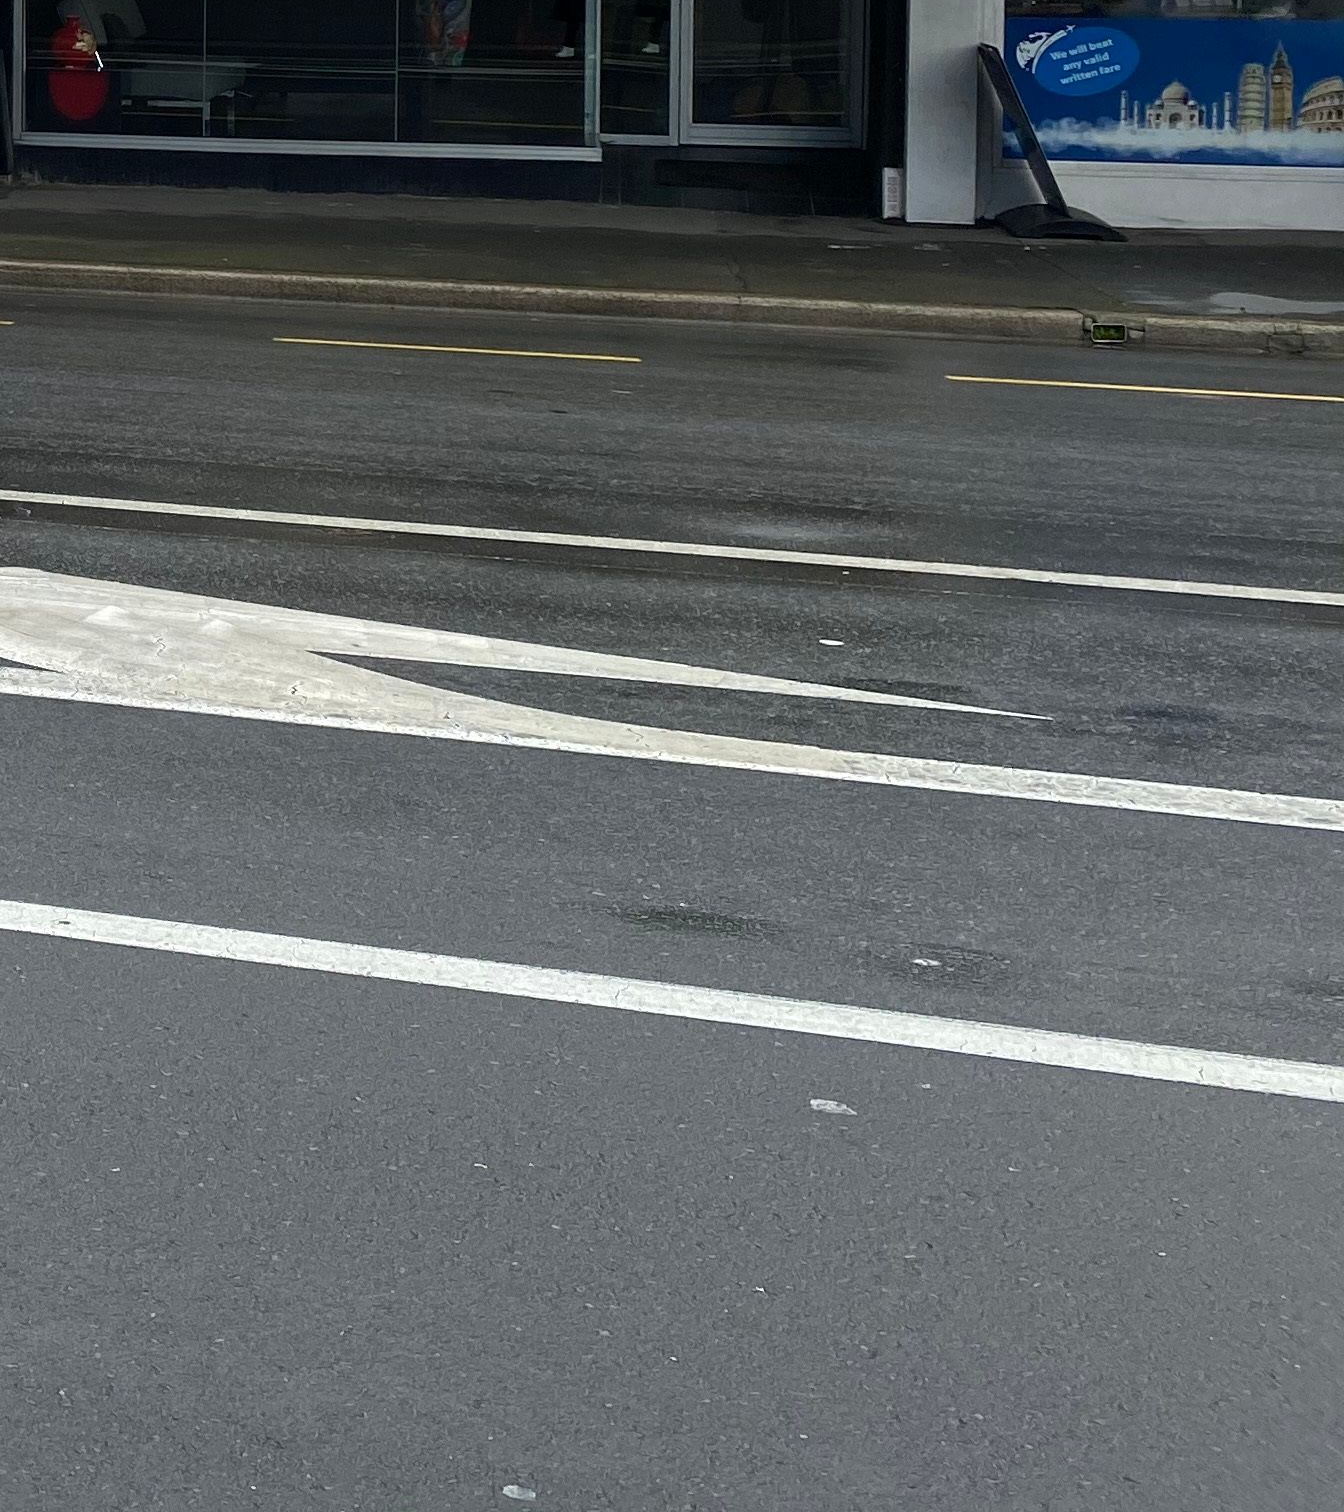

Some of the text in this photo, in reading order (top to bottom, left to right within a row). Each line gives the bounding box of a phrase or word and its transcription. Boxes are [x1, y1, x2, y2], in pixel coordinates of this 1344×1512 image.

[1063, 52, 1110, 71] any valid
[1060, 64, 1121, 85] written fare
